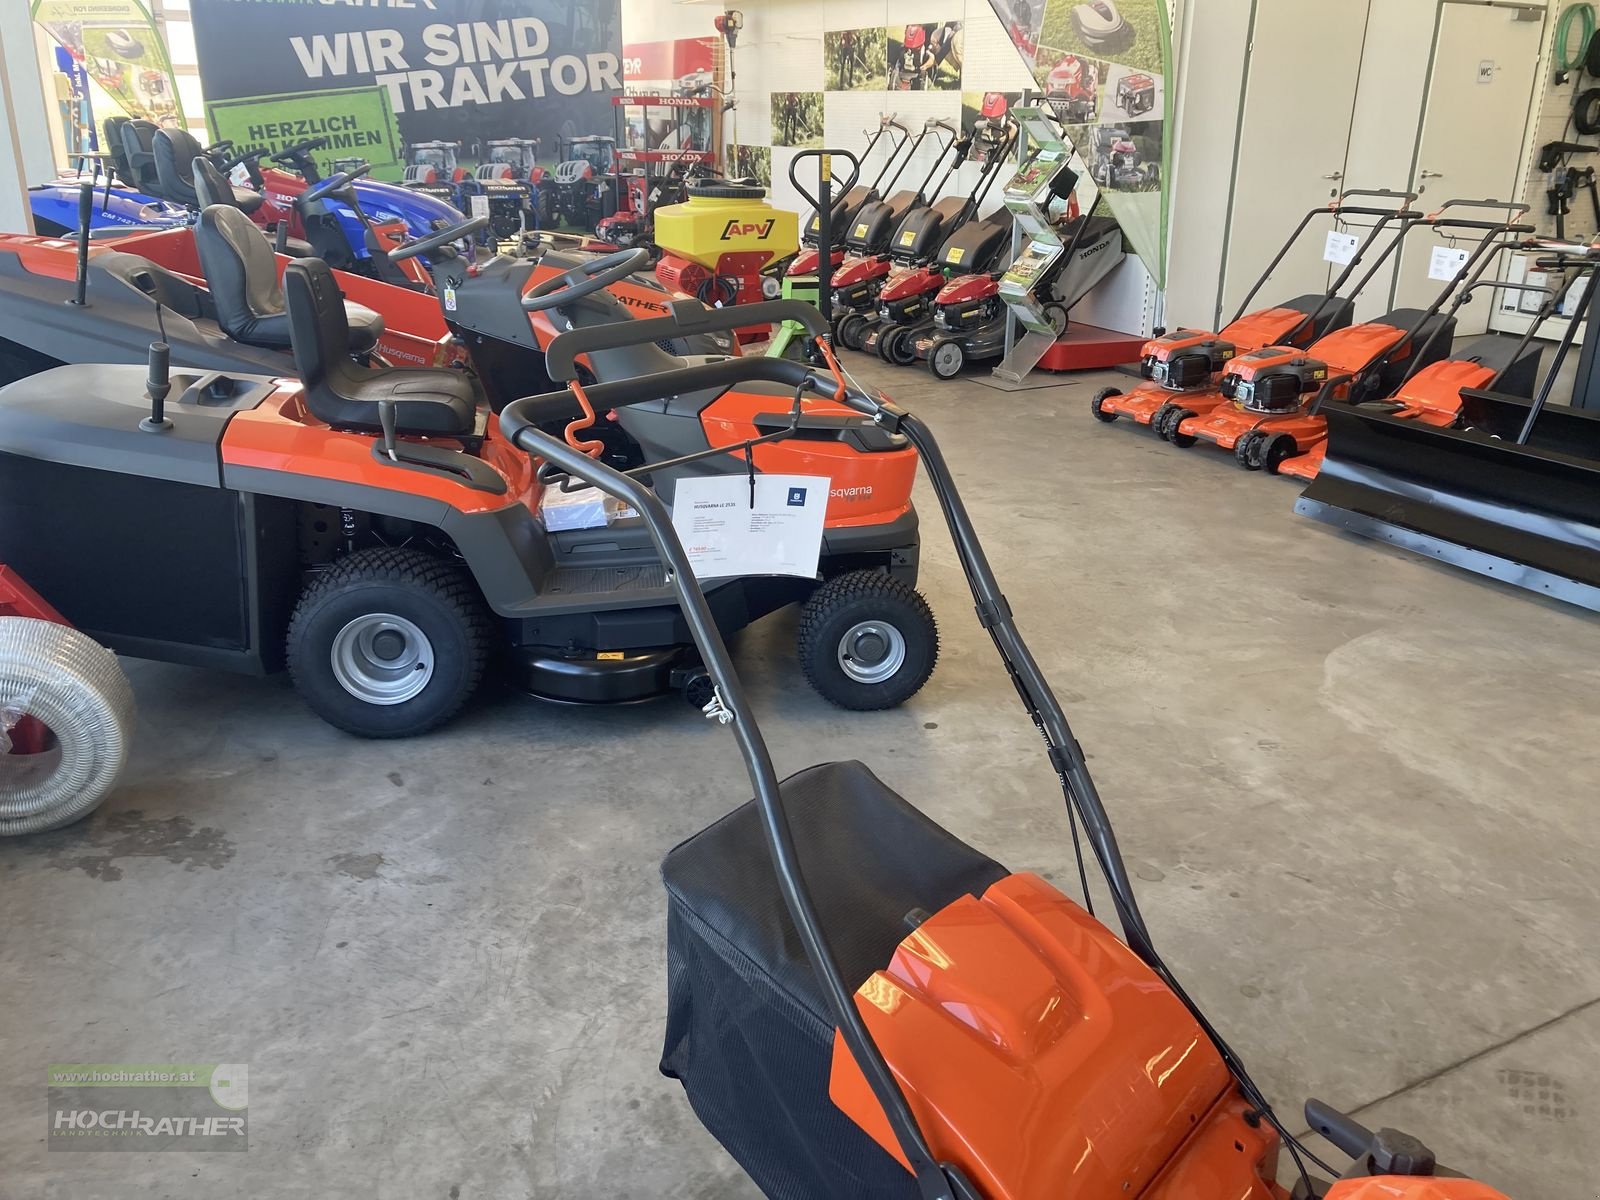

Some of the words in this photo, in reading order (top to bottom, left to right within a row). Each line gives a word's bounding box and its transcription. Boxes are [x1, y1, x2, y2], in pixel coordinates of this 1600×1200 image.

[289, 29, 410, 78] WIR
[422, 17, 549, 66] SIND
[624, 58, 642, 75] EYR
[1480, 67, 1492, 77] WC
[375, 52, 623, 114] TRAKTOR
[248, 115, 358, 141] HERZLICH
[101, 212, 115, 220] CM
[1079, 240, 1110, 260] HONDA
[613, 293, 668, 314] ATHER
[379, 343, 426, 365] Husqvarna
[830, 485, 873, 499] sqvarna
